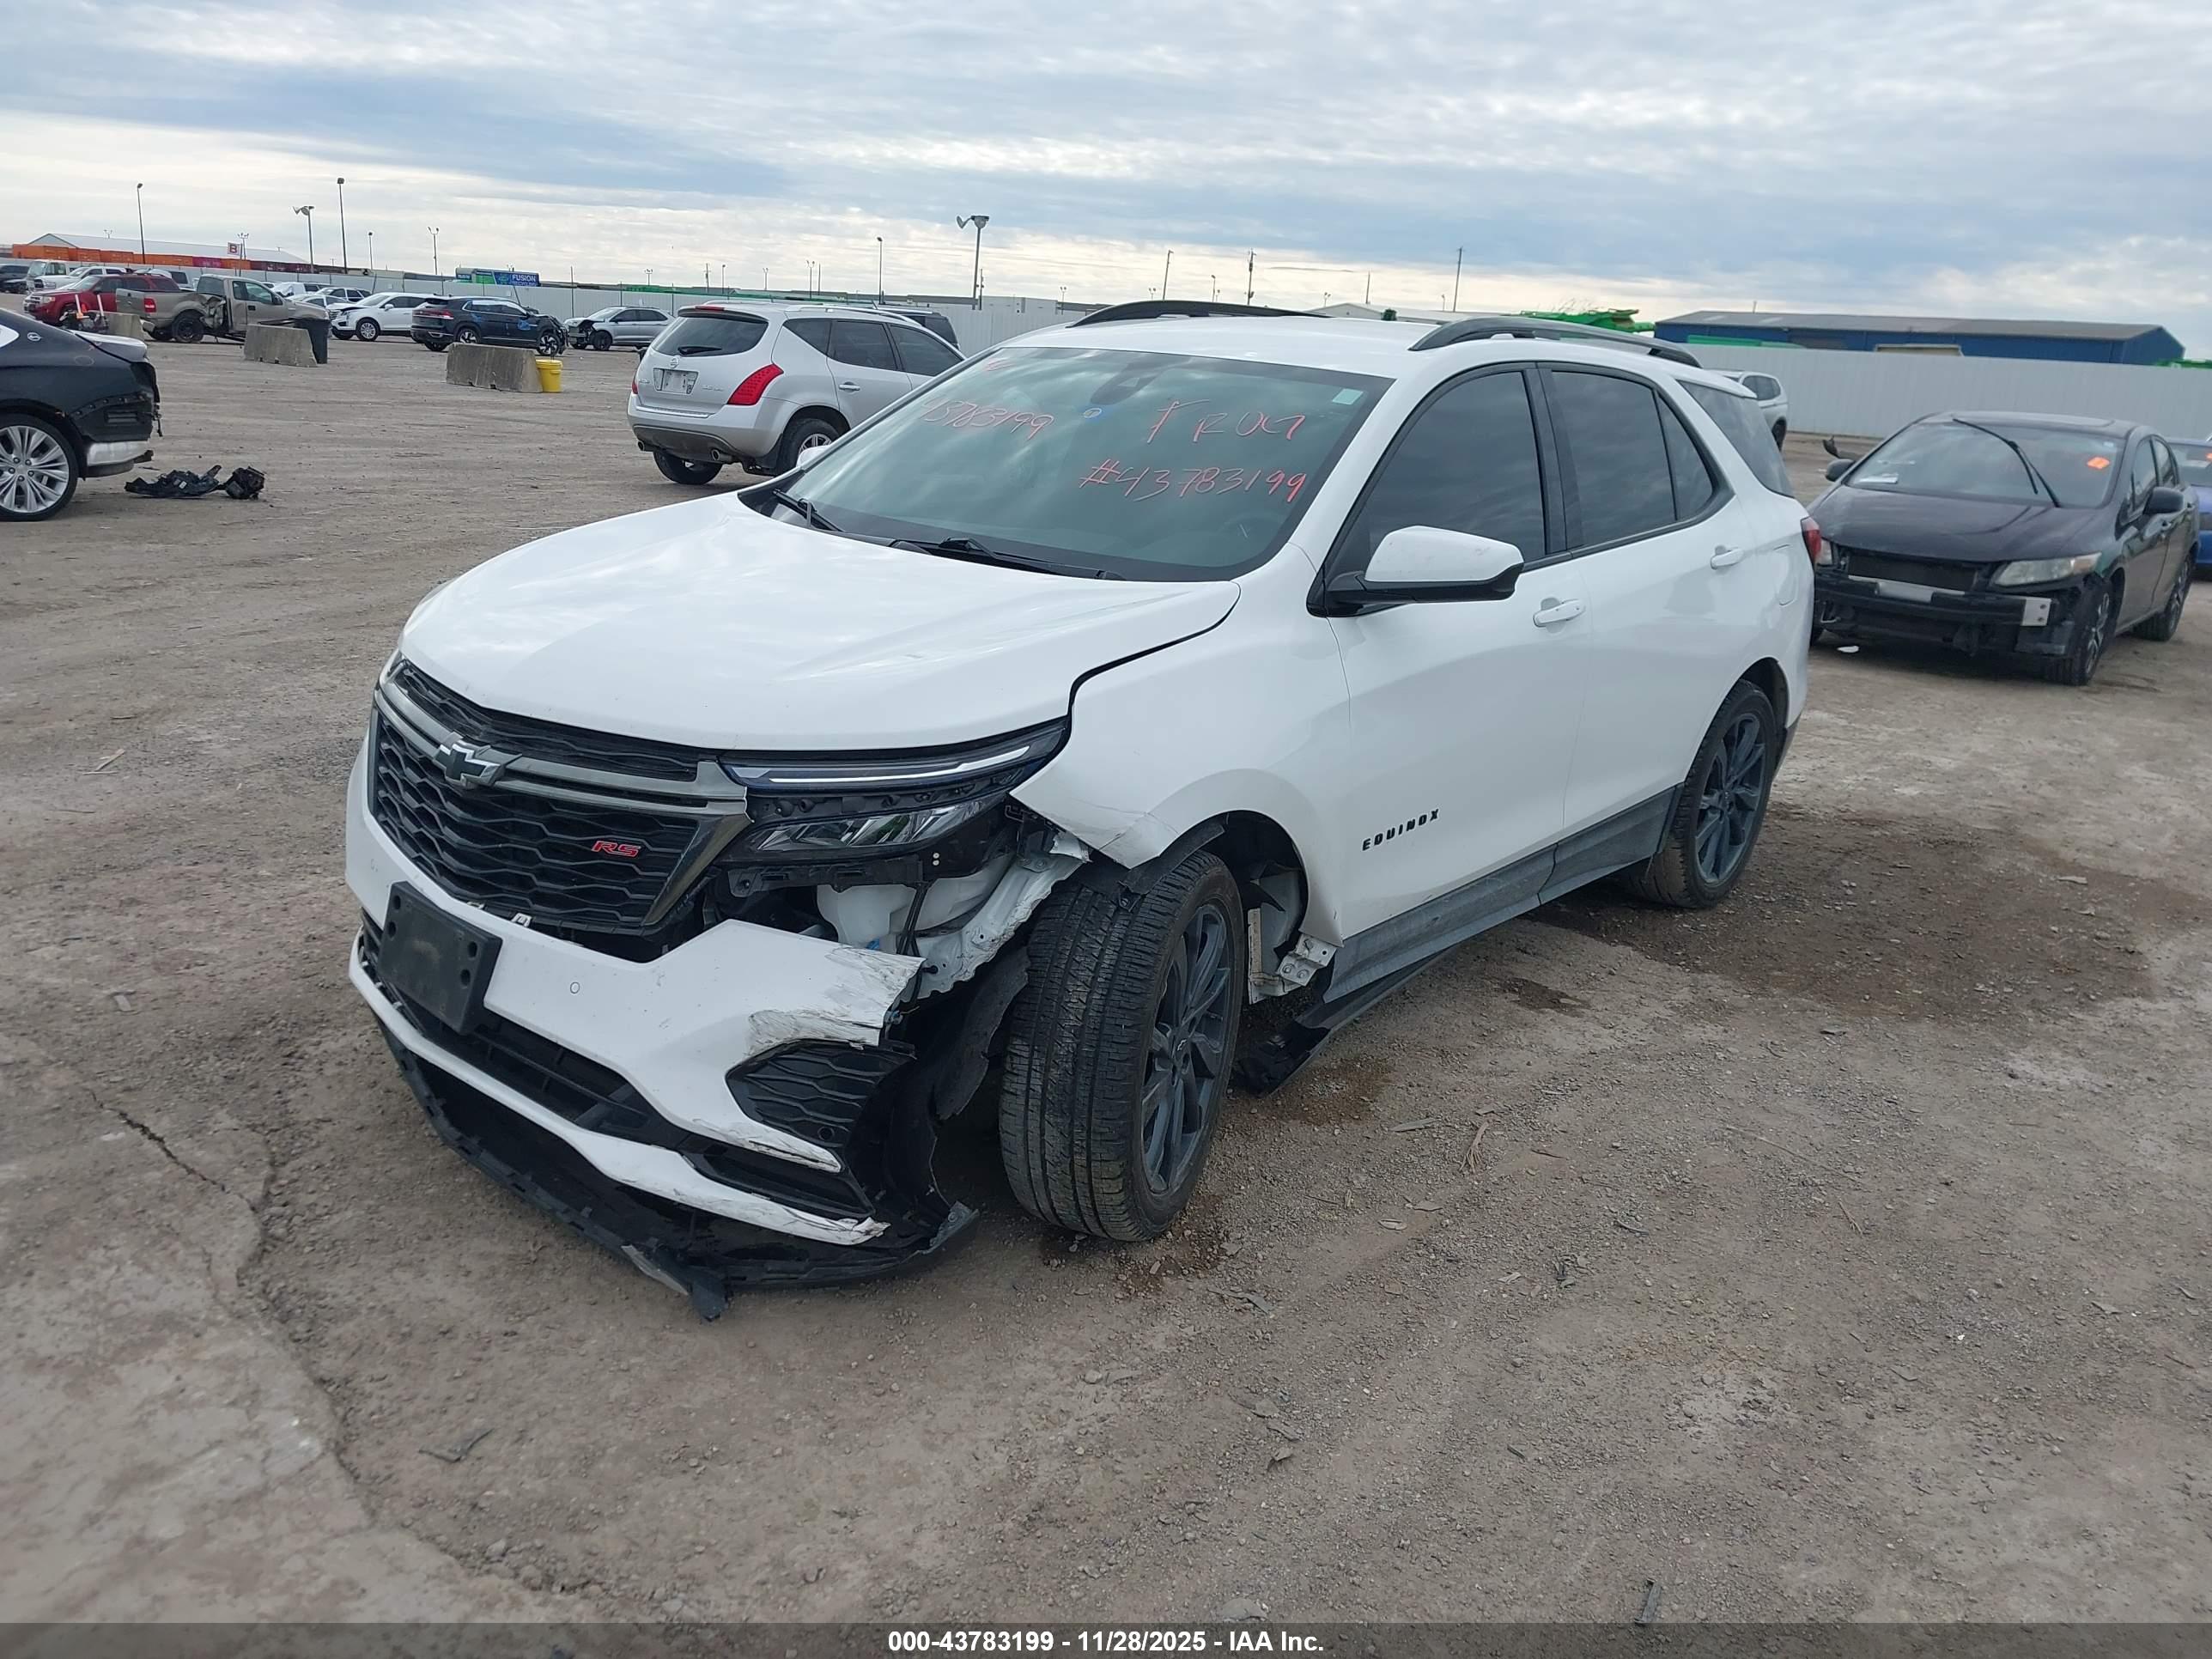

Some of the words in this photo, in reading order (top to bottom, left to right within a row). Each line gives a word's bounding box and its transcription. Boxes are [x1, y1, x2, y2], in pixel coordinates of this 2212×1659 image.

[512, 274, 537, 283] FUSION
[1362, 809, 1439, 851] EQUINOX
[591, 840, 641, 857] RS
